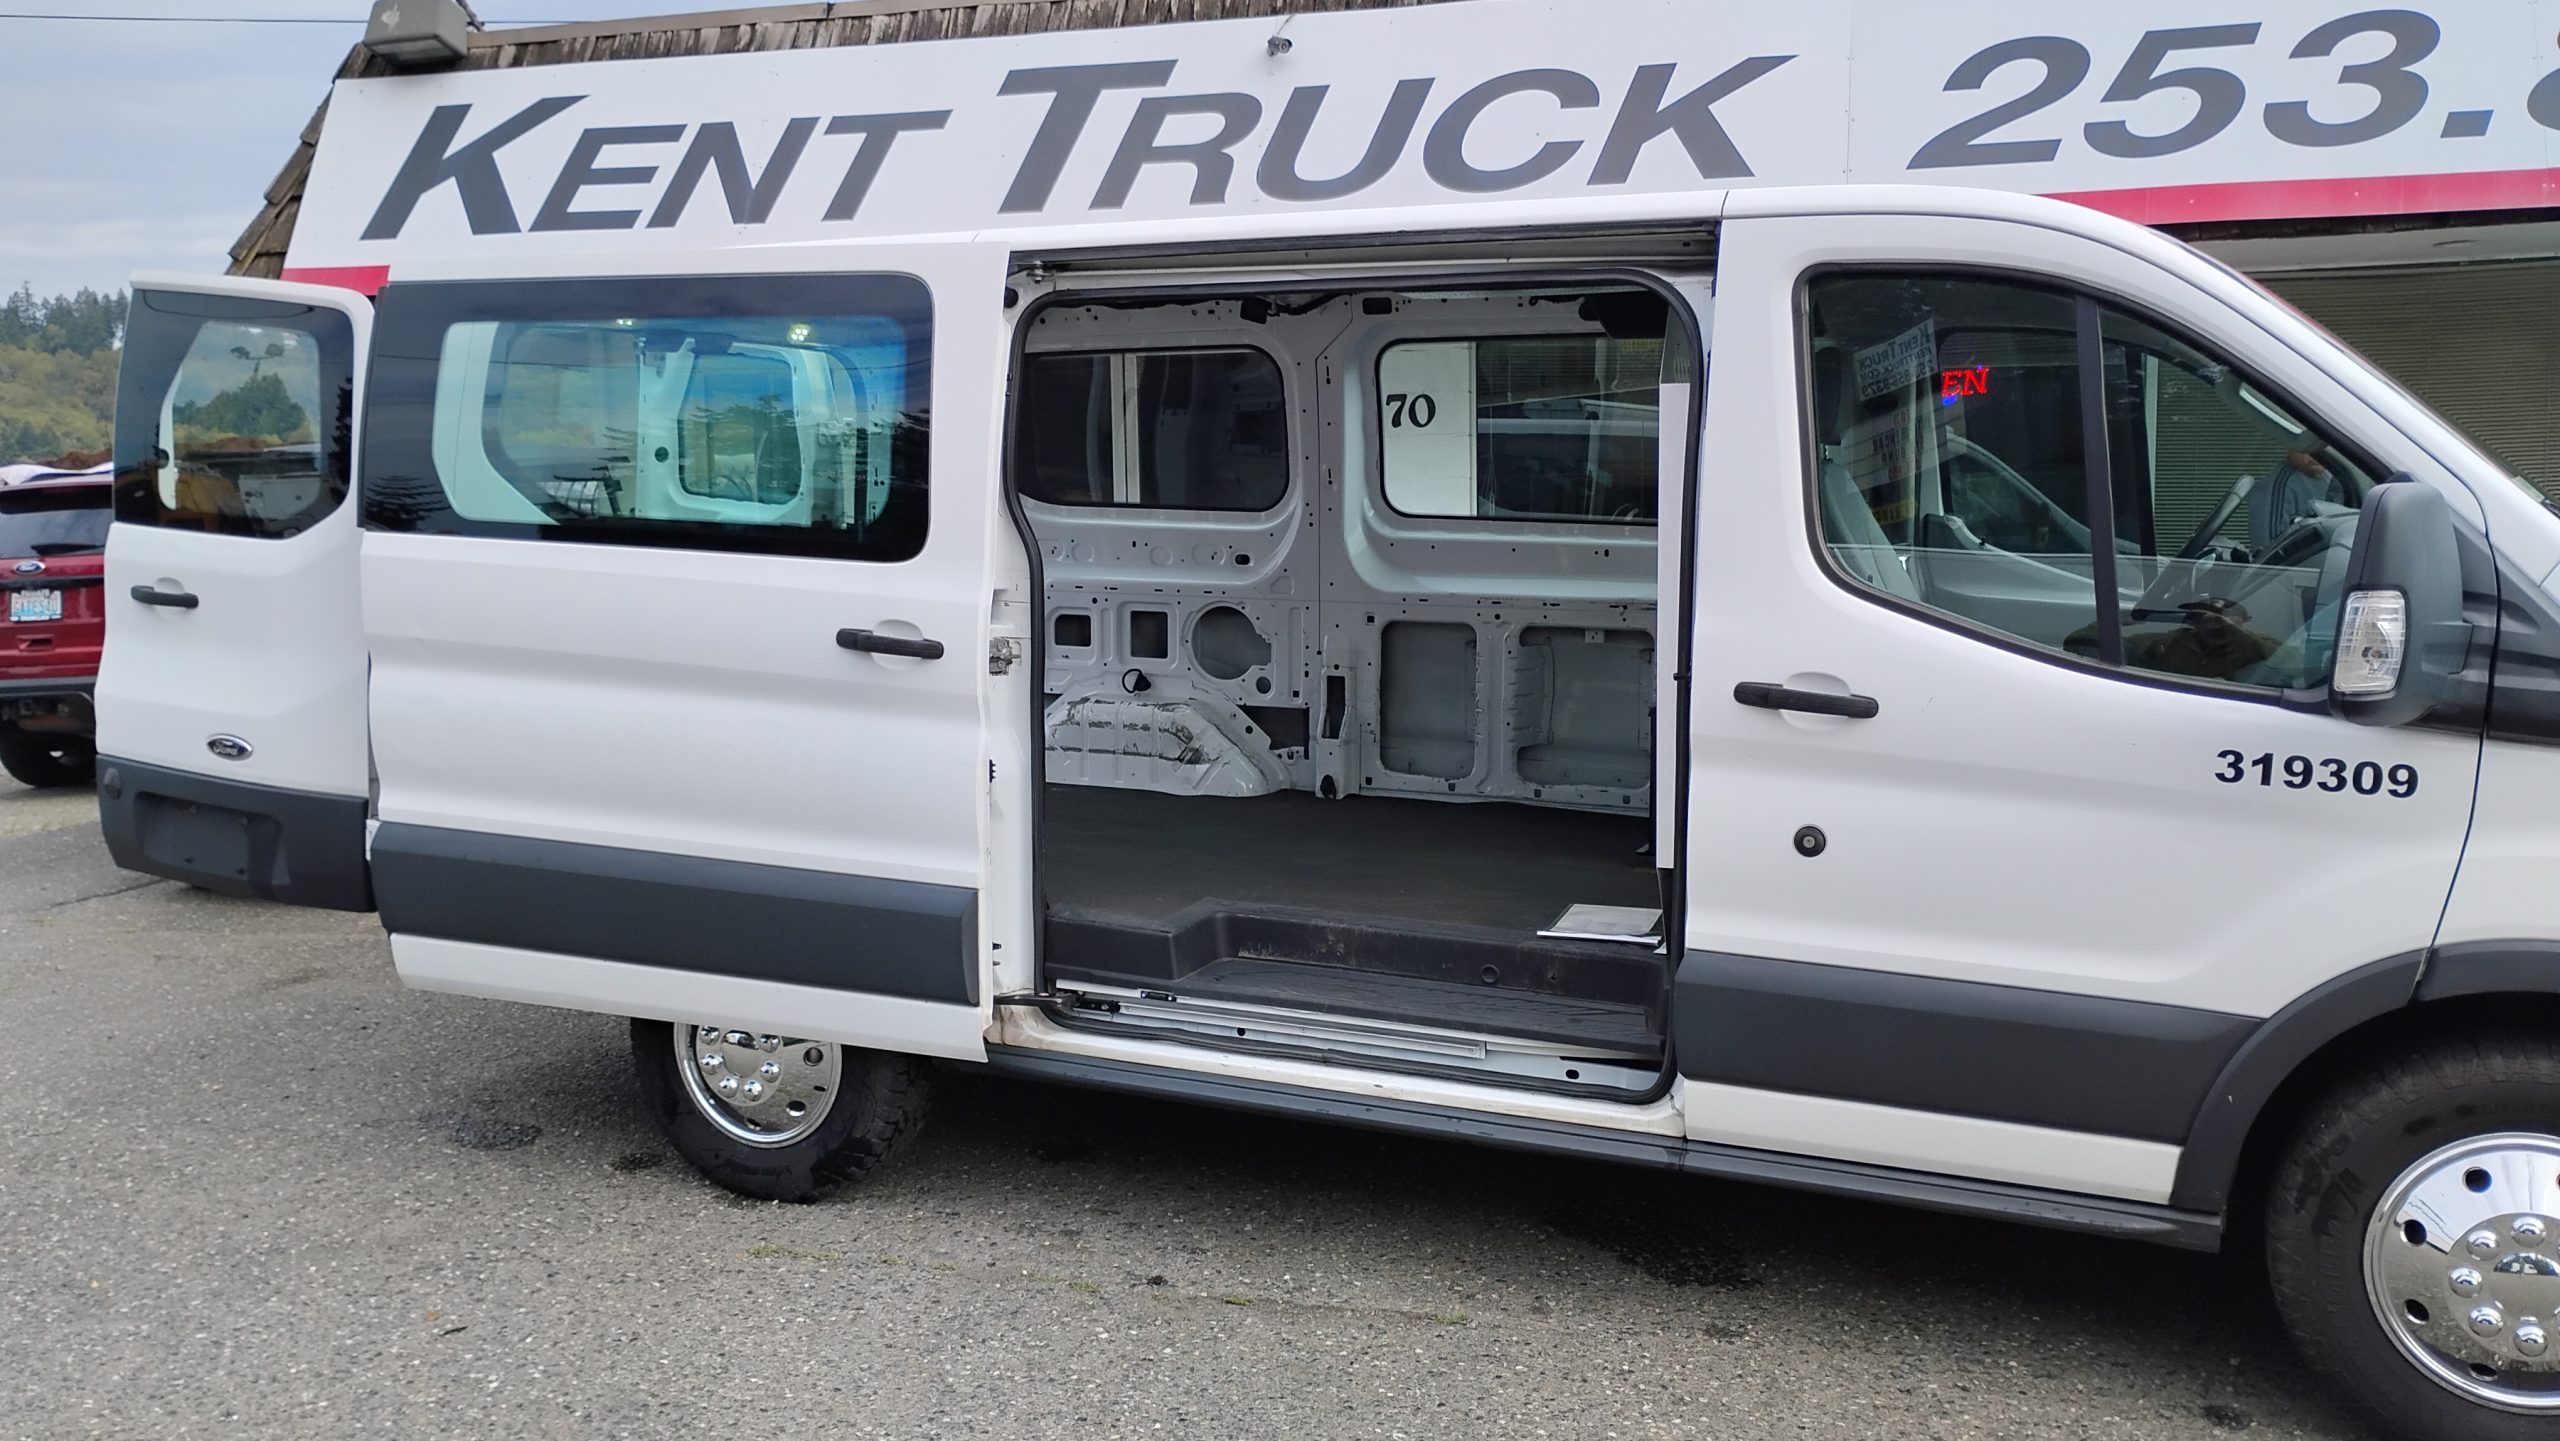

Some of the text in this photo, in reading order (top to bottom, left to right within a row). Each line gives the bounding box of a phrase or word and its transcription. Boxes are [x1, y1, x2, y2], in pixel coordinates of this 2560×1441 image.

[1905, 8, 2560, 170] 253.
[1386, 393, 1436, 428] 70
[2214, 749, 2419, 798] 319309
